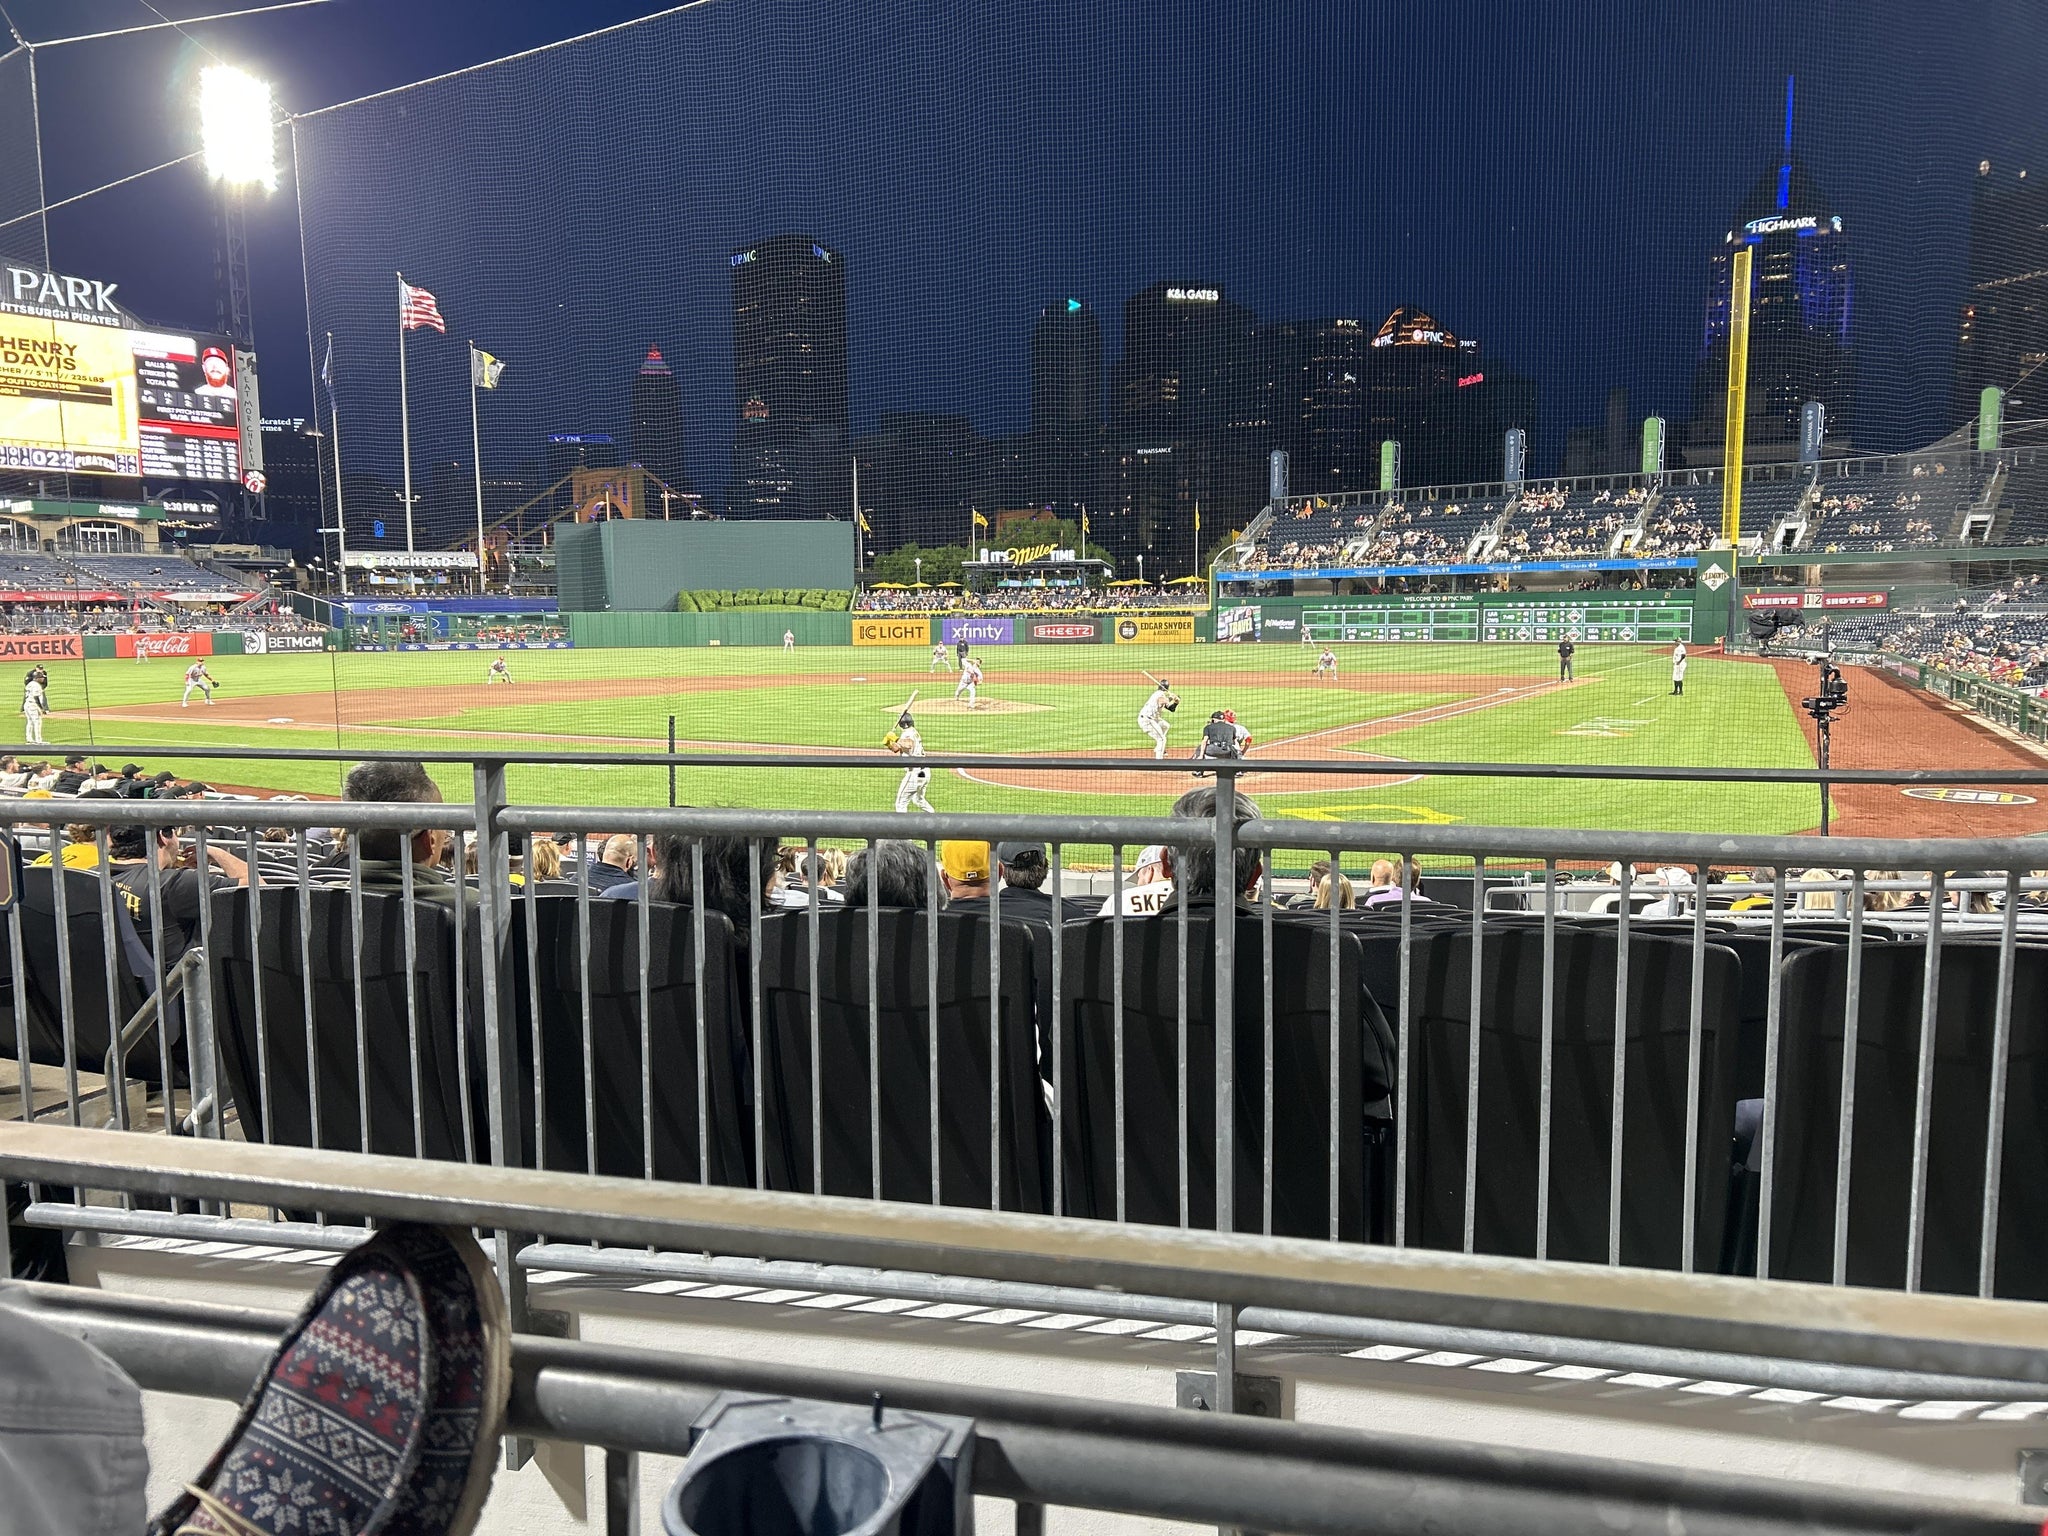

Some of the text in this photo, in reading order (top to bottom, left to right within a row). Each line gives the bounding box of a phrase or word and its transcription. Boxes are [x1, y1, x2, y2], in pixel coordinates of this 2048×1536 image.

[1751, 216, 1817, 234] HIGHMARK
[730, 250, 757, 266] UPMC
[812, 243, 832, 263] UPMC
[7, 268, 120, 314] PARK
[1166, 288, 1219, 301] K&L GATES
[71, 311, 120, 327] PIRATES
[1343, 319, 1359, 327] PNC
[1380, 332, 1394, 347] PNC
[1423, 331, 1444, 343] PNC
[0, 336, 77, 357] HENRY
[3, 350, 76, 371] DAVIS
[71, 374, 87, 382] 225
[244, 401, 252, 423] MOR
[9, 447, 17, 455] 0
[247, 426, 255, 468] CHIKIN
[10, 457, 18, 465] 0
[74, 455, 116, 471] PIRATES
[183, 502, 200, 512] PM
[380, 556, 465, 567] FAT HEAD'S
[990, 542, 1075, 566] IT'S Miller TIME
[375, 604, 404, 612] Ford
[859, 625, 924, 640] IC LIGHT
[952, 623, 1004, 640] xfinity
[1038, 626, 1090, 636] SHEETZ
[1140, 622, 1163, 630] EDGAR
[1163, 621, 1192, 630] SNYDER
[1229, 617, 1253, 636] TRAVEL
[268, 636, 323, 648] BETMGM
